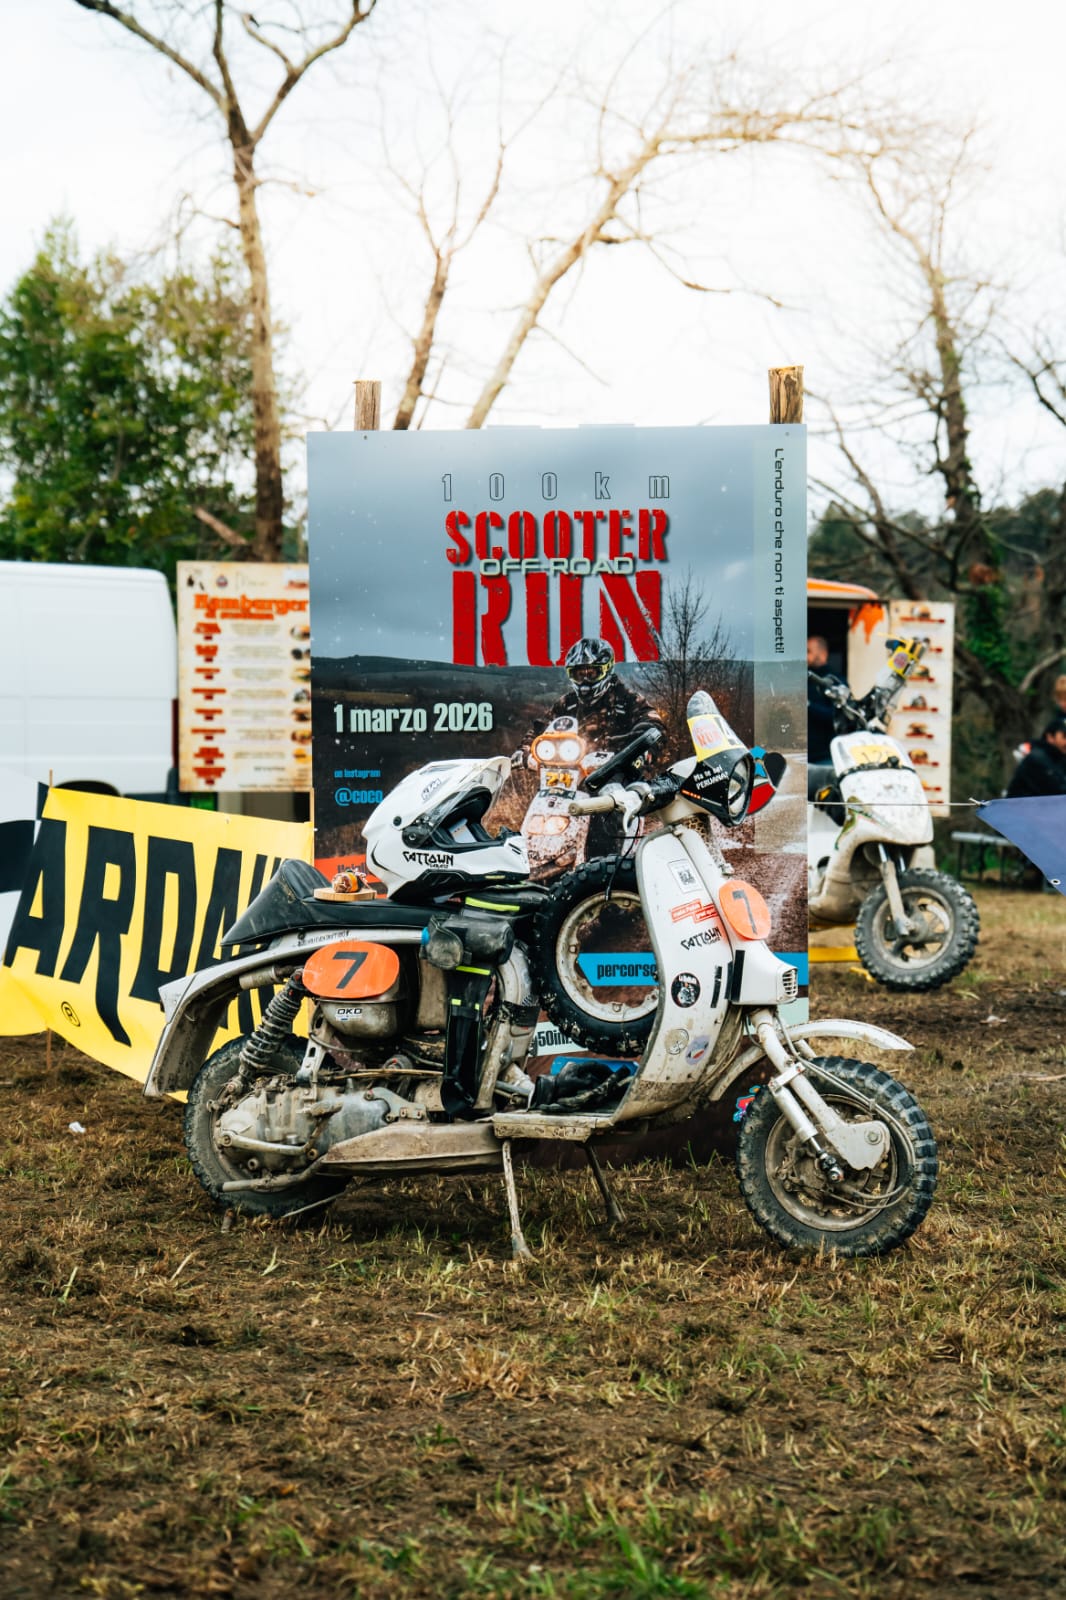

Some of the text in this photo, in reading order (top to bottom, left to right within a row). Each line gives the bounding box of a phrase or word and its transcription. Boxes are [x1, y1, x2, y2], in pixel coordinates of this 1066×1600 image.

[445, 508, 668, 565] SCOOTER
[772, 448, 785, 654] L'enduro che non ti aspetti!
[479, 556, 635, 577] OFF-ROAD
[452, 569, 662, 668] RUN
[333, 702, 494, 733] 1 marzo 2026
[545, 771, 574, 789] 24
[731, 889, 758, 936] 7
[332, 951, 369, 990] 7
